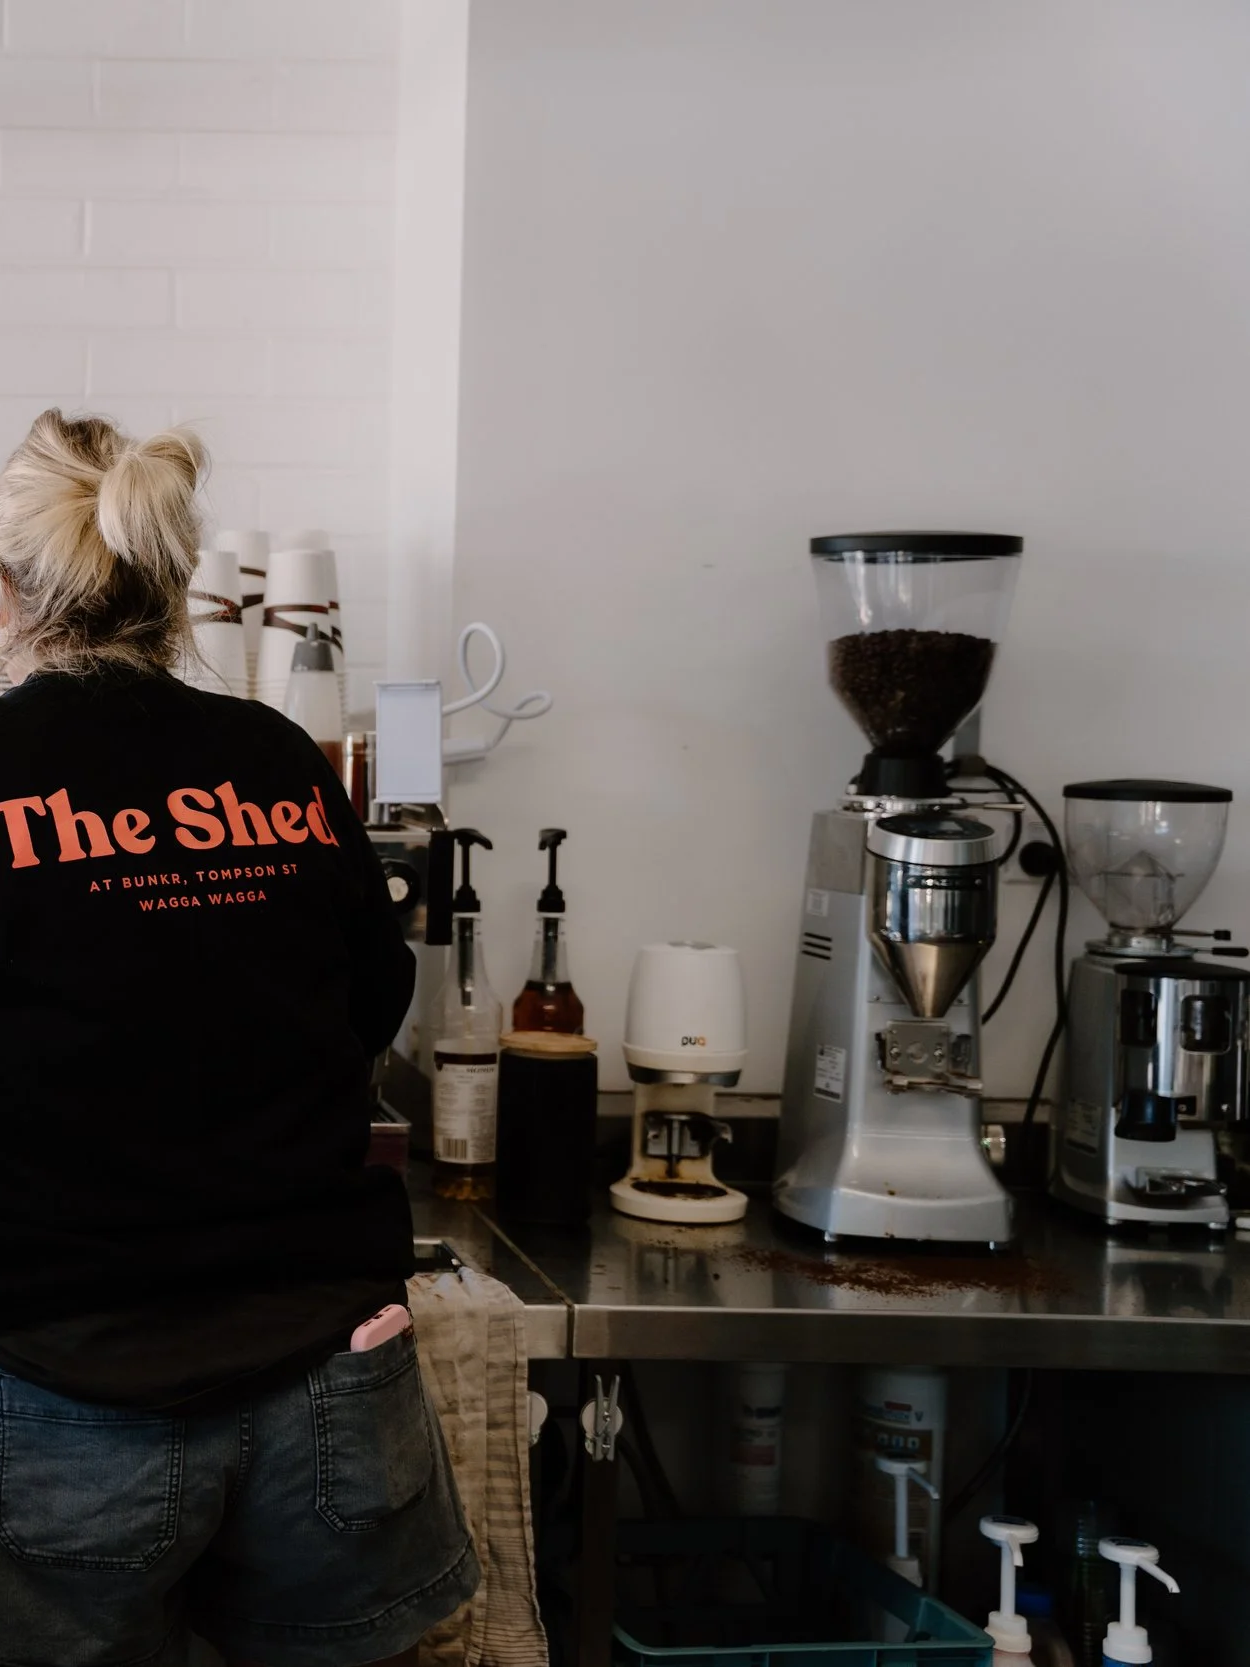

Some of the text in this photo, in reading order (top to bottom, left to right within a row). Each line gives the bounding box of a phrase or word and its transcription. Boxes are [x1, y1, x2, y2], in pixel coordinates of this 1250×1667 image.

[167, 781, 340, 850] Shed
[90, 864, 299, 893] AT BUNKR, TOMPSON ST
[139, 890, 267, 912] WAGGA WAGGA
